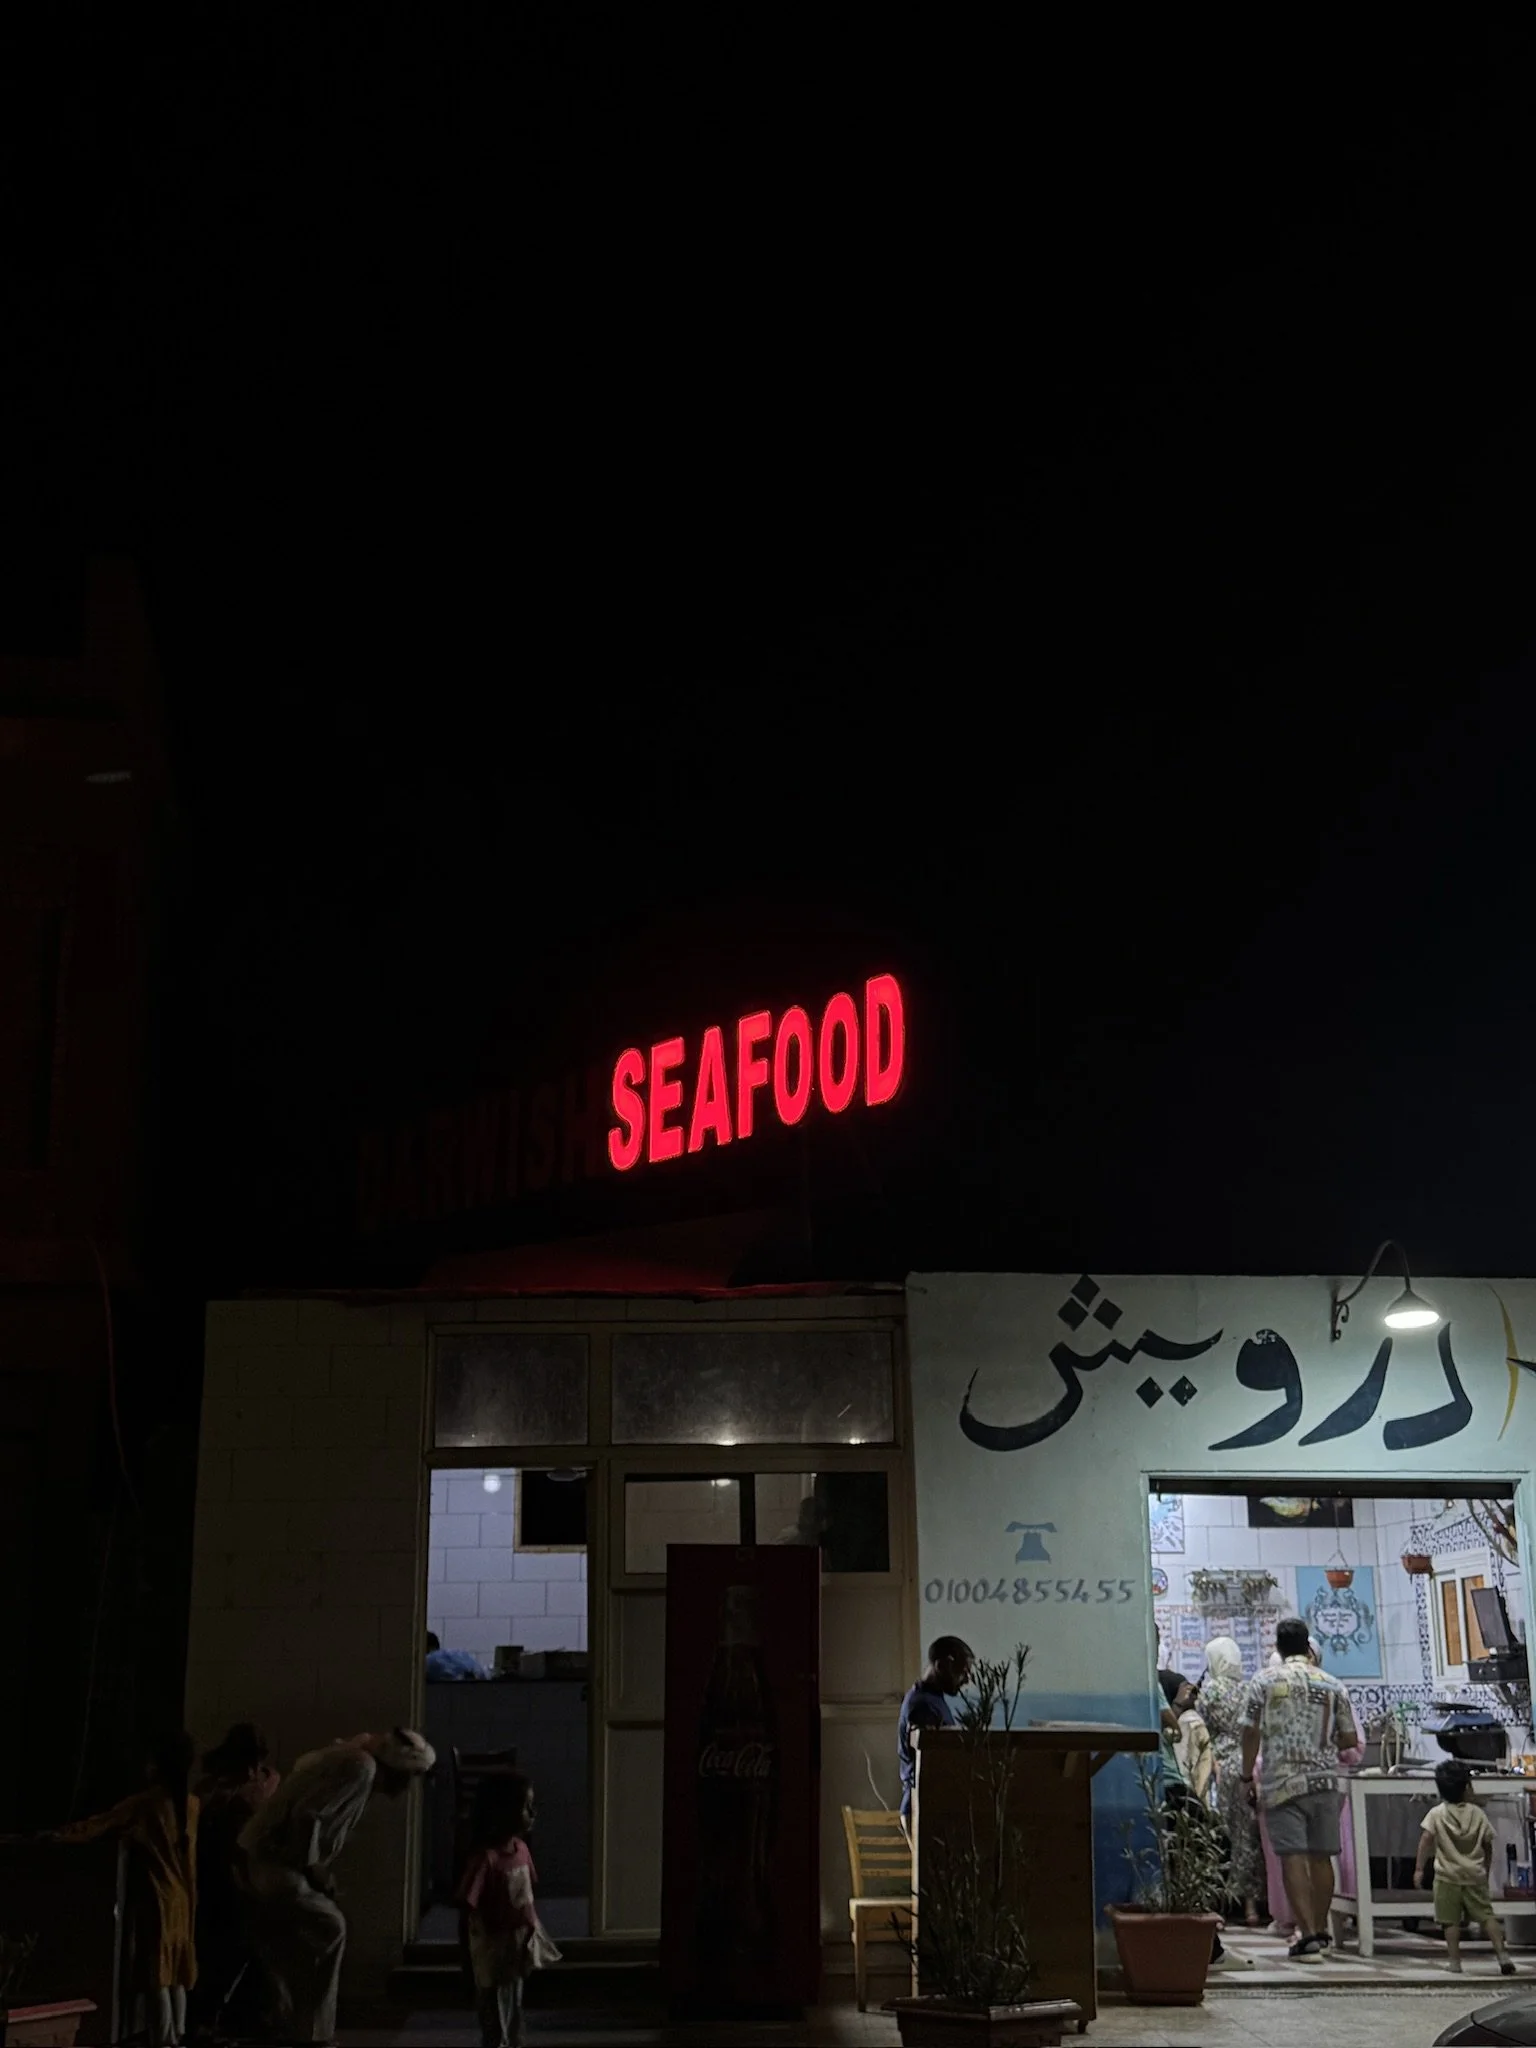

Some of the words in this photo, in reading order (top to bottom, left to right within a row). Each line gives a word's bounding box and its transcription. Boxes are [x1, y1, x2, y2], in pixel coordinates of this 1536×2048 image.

[608, 973, 904, 1171] SEAFOOD
[959, 1273, 1474, 1452] درويش
[924, 1577, 1135, 1605] 01004855455
